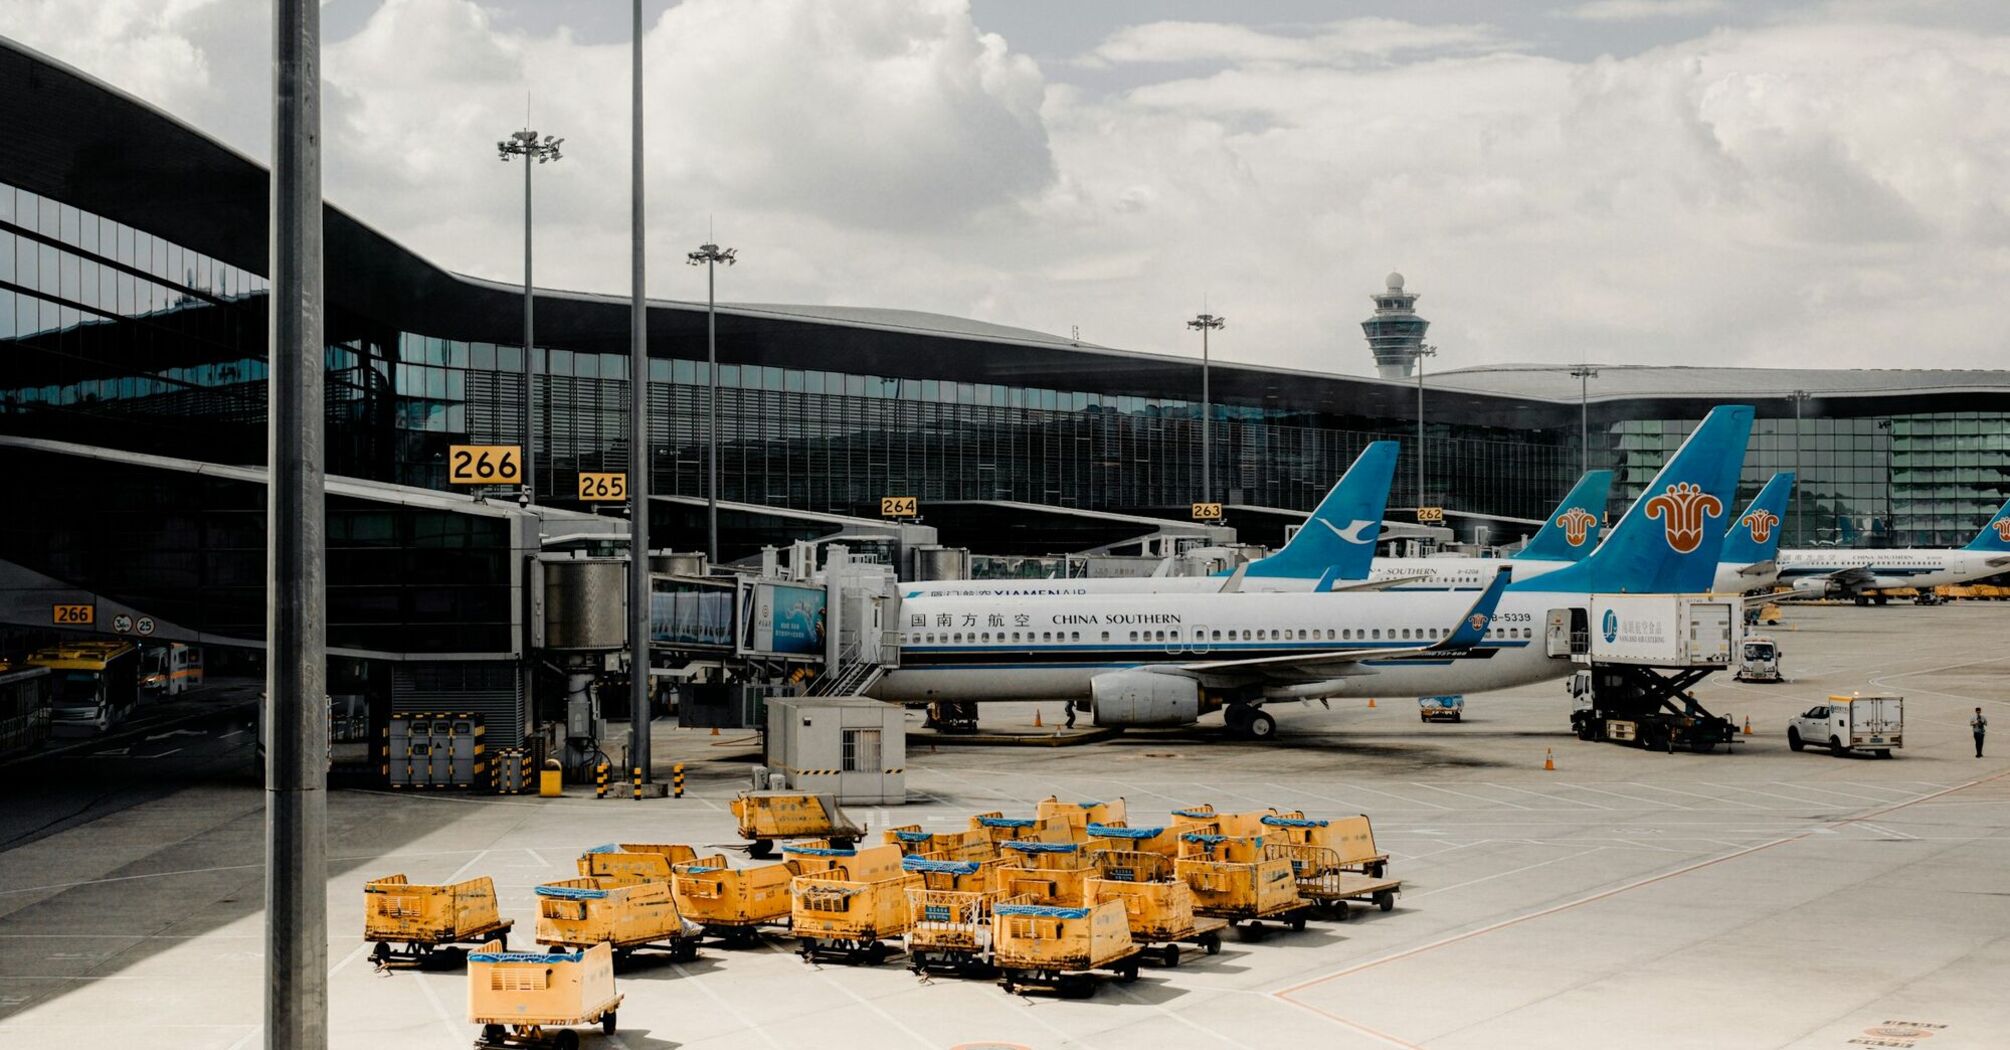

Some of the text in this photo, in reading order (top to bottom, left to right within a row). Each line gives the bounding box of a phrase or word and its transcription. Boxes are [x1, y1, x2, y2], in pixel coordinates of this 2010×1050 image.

[454, 451, 517, 478] 266
[582, 477, 623, 497] 265
[884, 499, 914, 513] 264
[1194, 505, 1220, 517] 263
[1419, 509, 1441, 519] 262
[58, 607, 89, 621] 266
[911, 613, 1031, 628] 国南方航空
[1052, 614, 1182, 625] CHINA SOUTHERN
[1491, 613, 1532, 622] B-5339
[139, 620, 152, 631] 25
